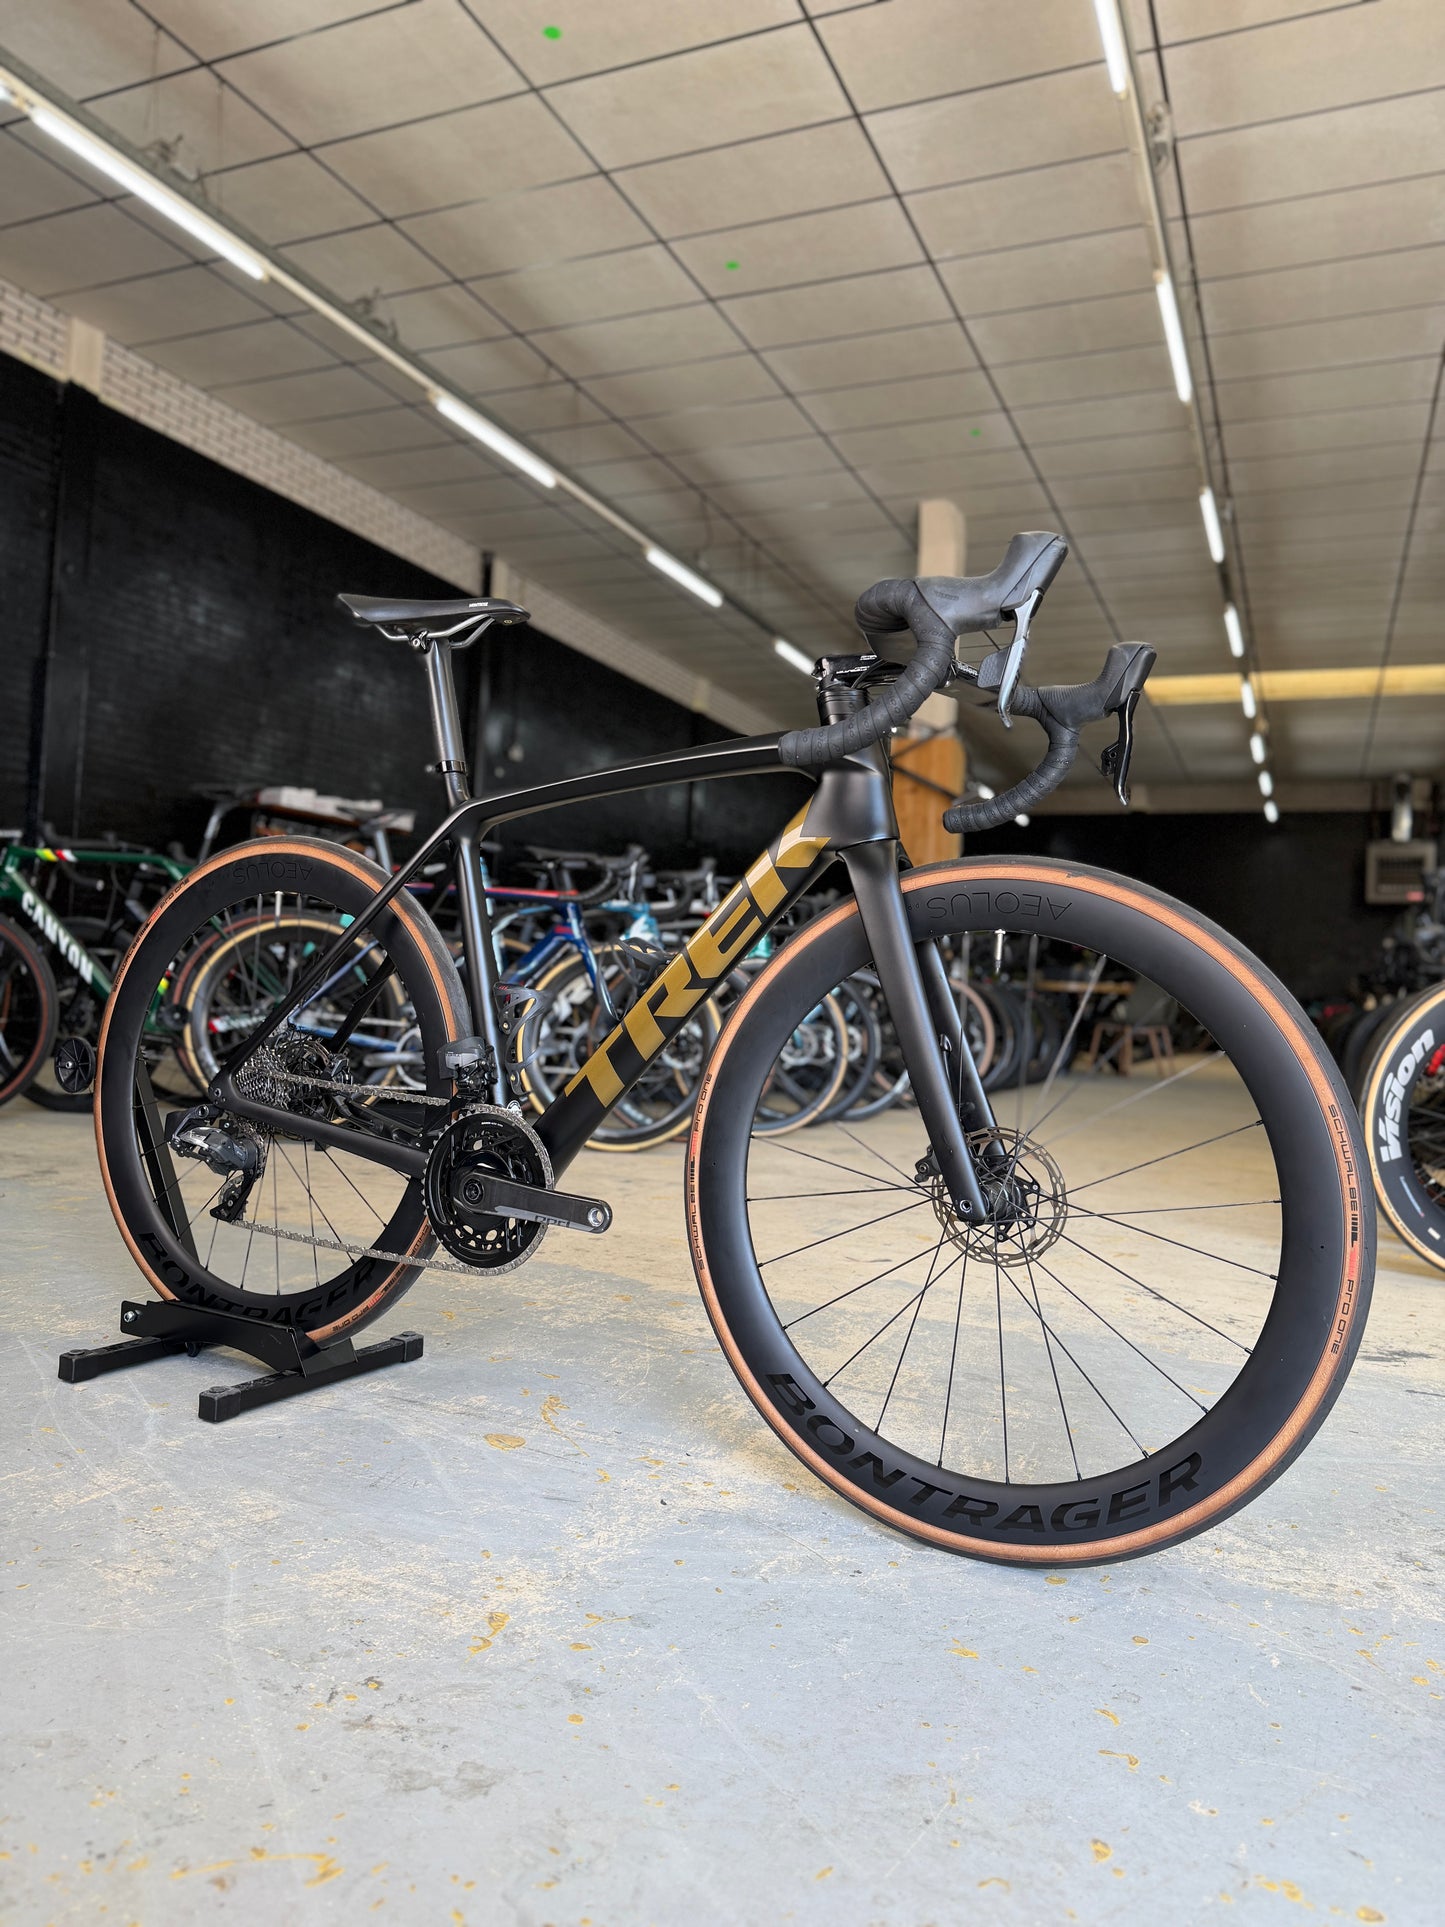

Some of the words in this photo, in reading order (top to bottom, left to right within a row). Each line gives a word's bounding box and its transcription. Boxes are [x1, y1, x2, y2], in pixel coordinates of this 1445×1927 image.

[233, 861, 313, 885] AEOLUS
[926, 891, 1073, 921] AEOLUS
[21, 890, 94, 984] CANYON
[565, 798, 830, 1107] TREK
[1328, 1104, 1359, 1212] SCHWALBE
[689, 1183, 706, 1271] SCHWALBE
[764, 1372, 1203, 1534] BONTRAGER
